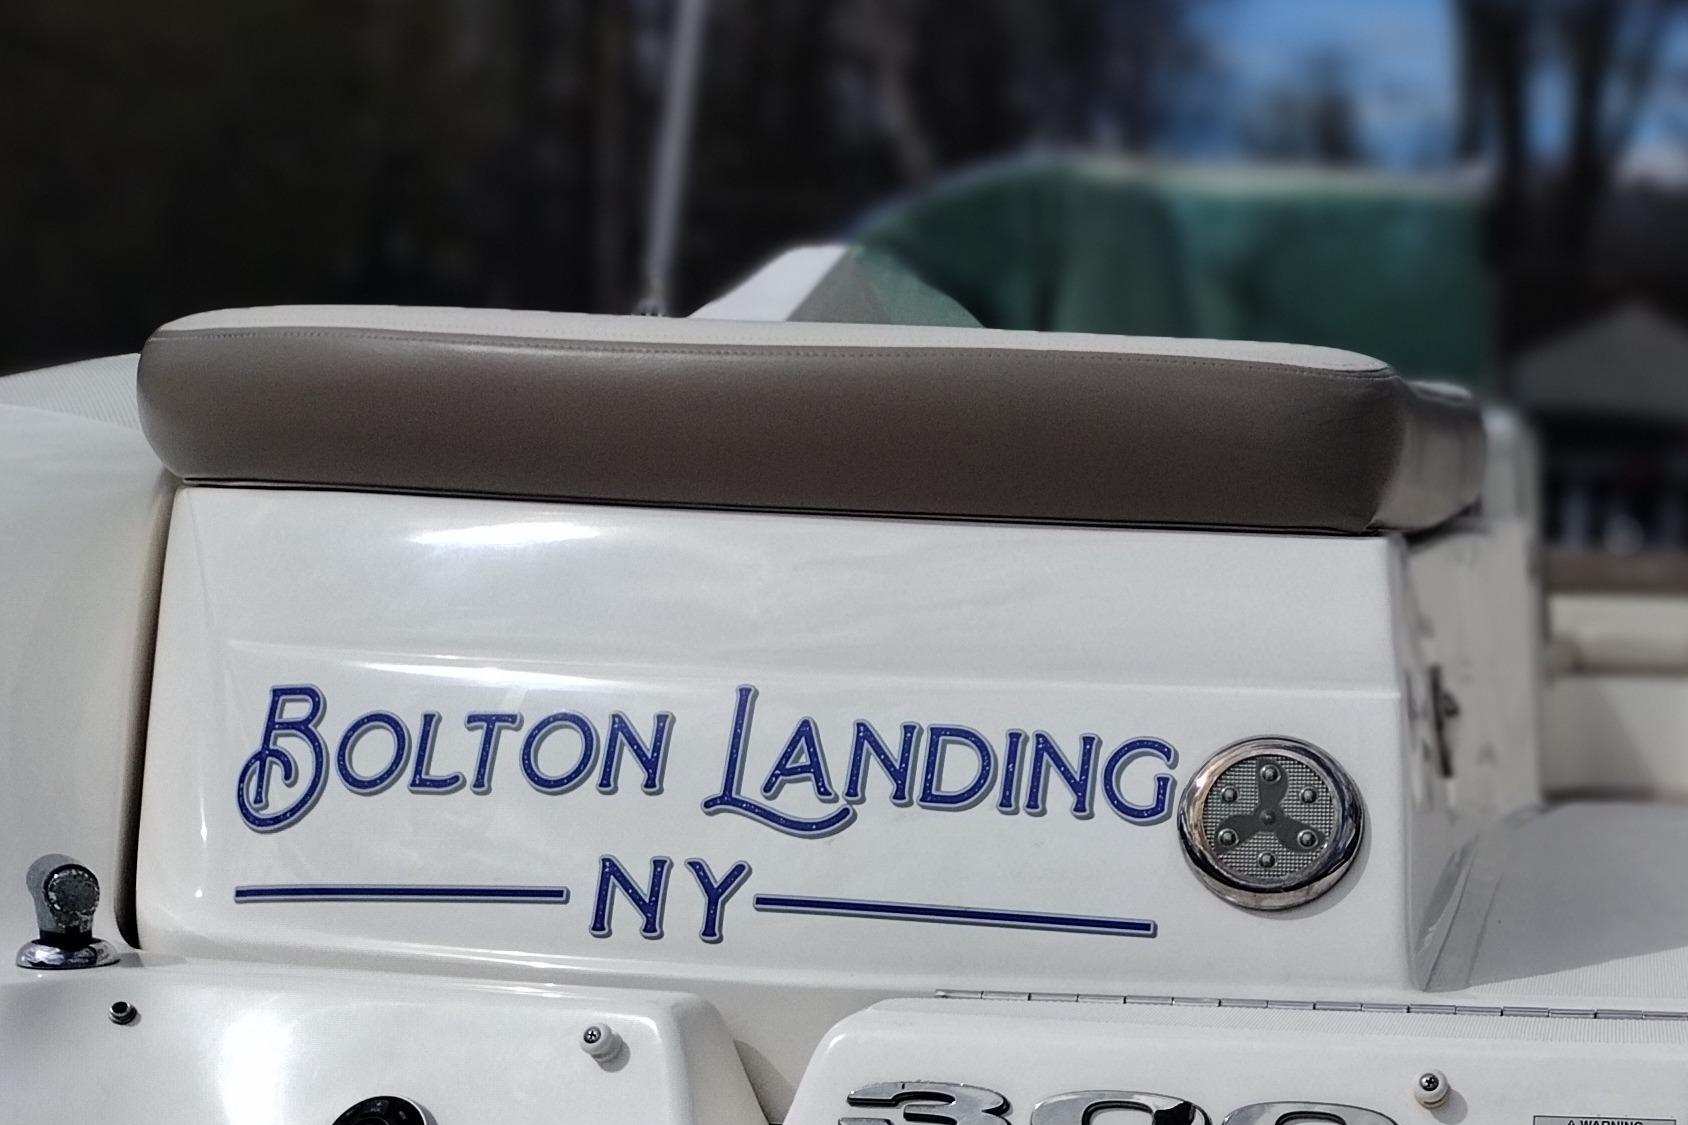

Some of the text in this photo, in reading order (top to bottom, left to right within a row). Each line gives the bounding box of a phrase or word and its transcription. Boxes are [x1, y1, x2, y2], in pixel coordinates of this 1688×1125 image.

[237, 684, 1179, 837] BOLTON LANDING
[590, 855, 752, 942] NY
